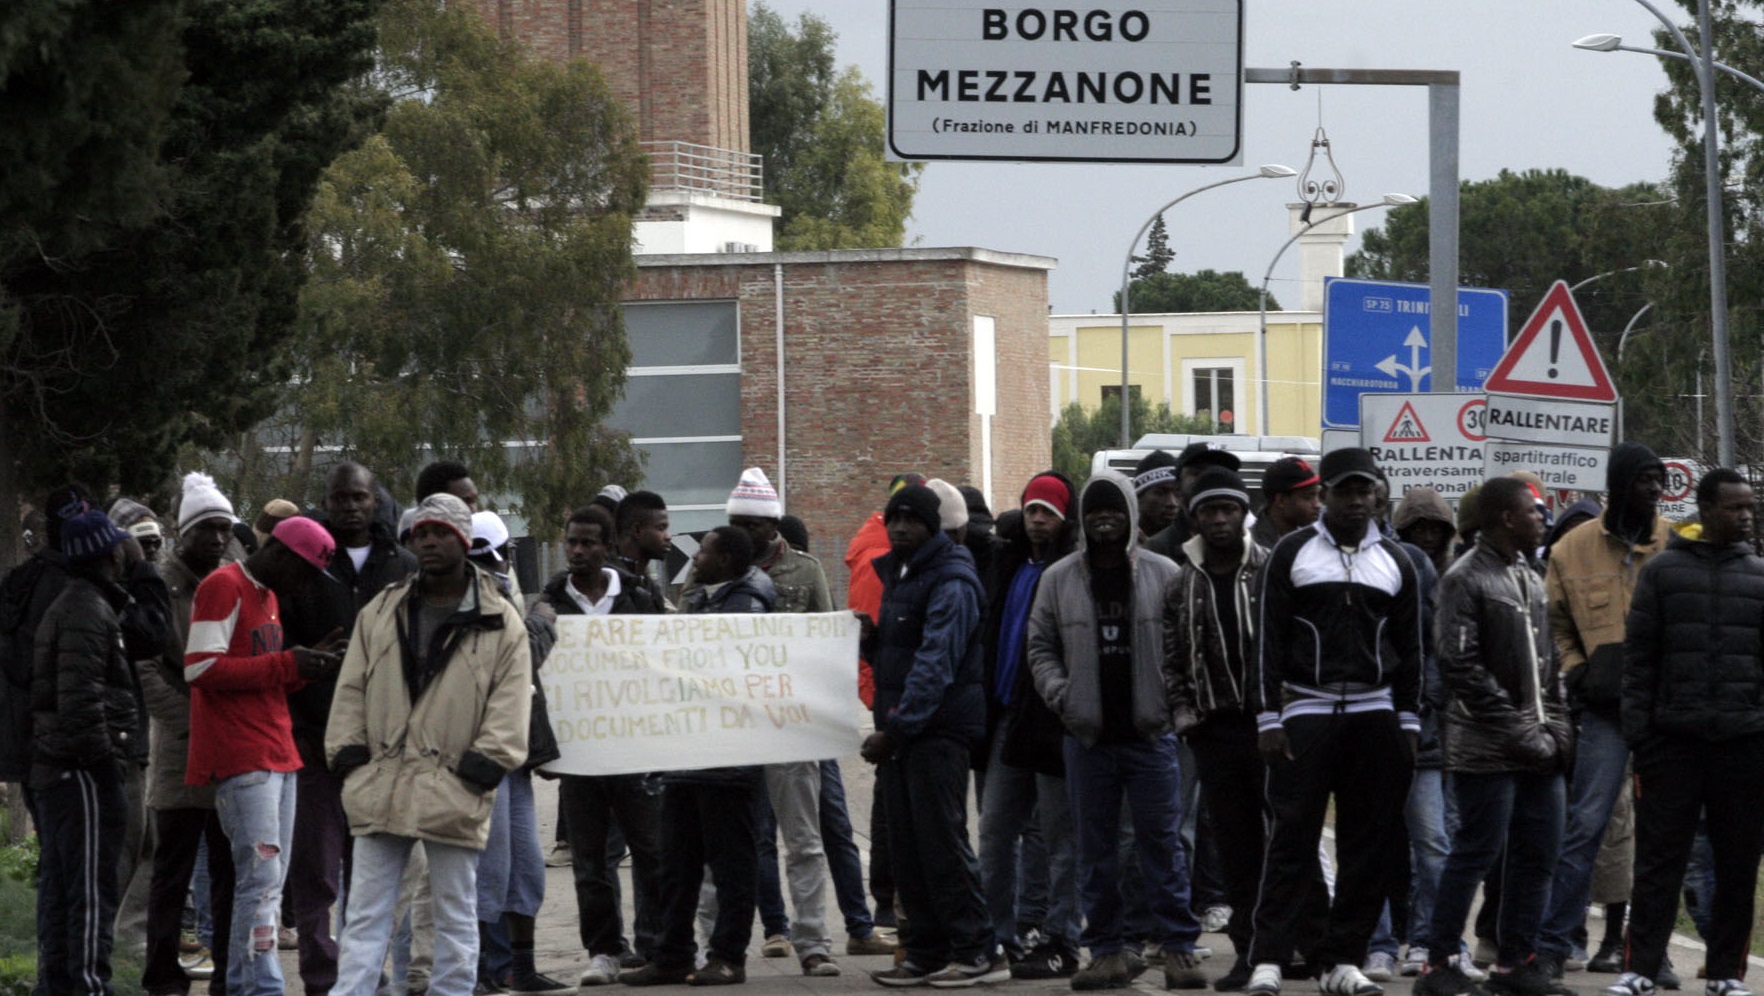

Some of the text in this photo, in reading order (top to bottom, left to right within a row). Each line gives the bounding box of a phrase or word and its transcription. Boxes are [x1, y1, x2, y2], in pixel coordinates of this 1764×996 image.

[982, 9, 1150, 42] BORGO
[917, 70, 1212, 105] MEZZANONE
[932, 117, 1197, 137] (Frazione di MANFREDONIA)
[1366, 299, 1469, 317] SP 75 TRINILI
[1489, 408, 1610, 434] RALLENTARE
[1370, 446, 1482, 462] RALLENTA
[1493, 450, 1598, 469] spartitraffico
[1533, 469, 1576, 485] trale
[558, 619, 576, 649] E
[585, 618, 646, 648] ARE
[653, 616, 793, 646] APPEALING
[662, 648, 726, 670] FROM
[735, 644, 788, 670] YOU
[745, 673, 794, 700] PER
[557, 703, 811, 744] DOCUMENTI DA VOI
